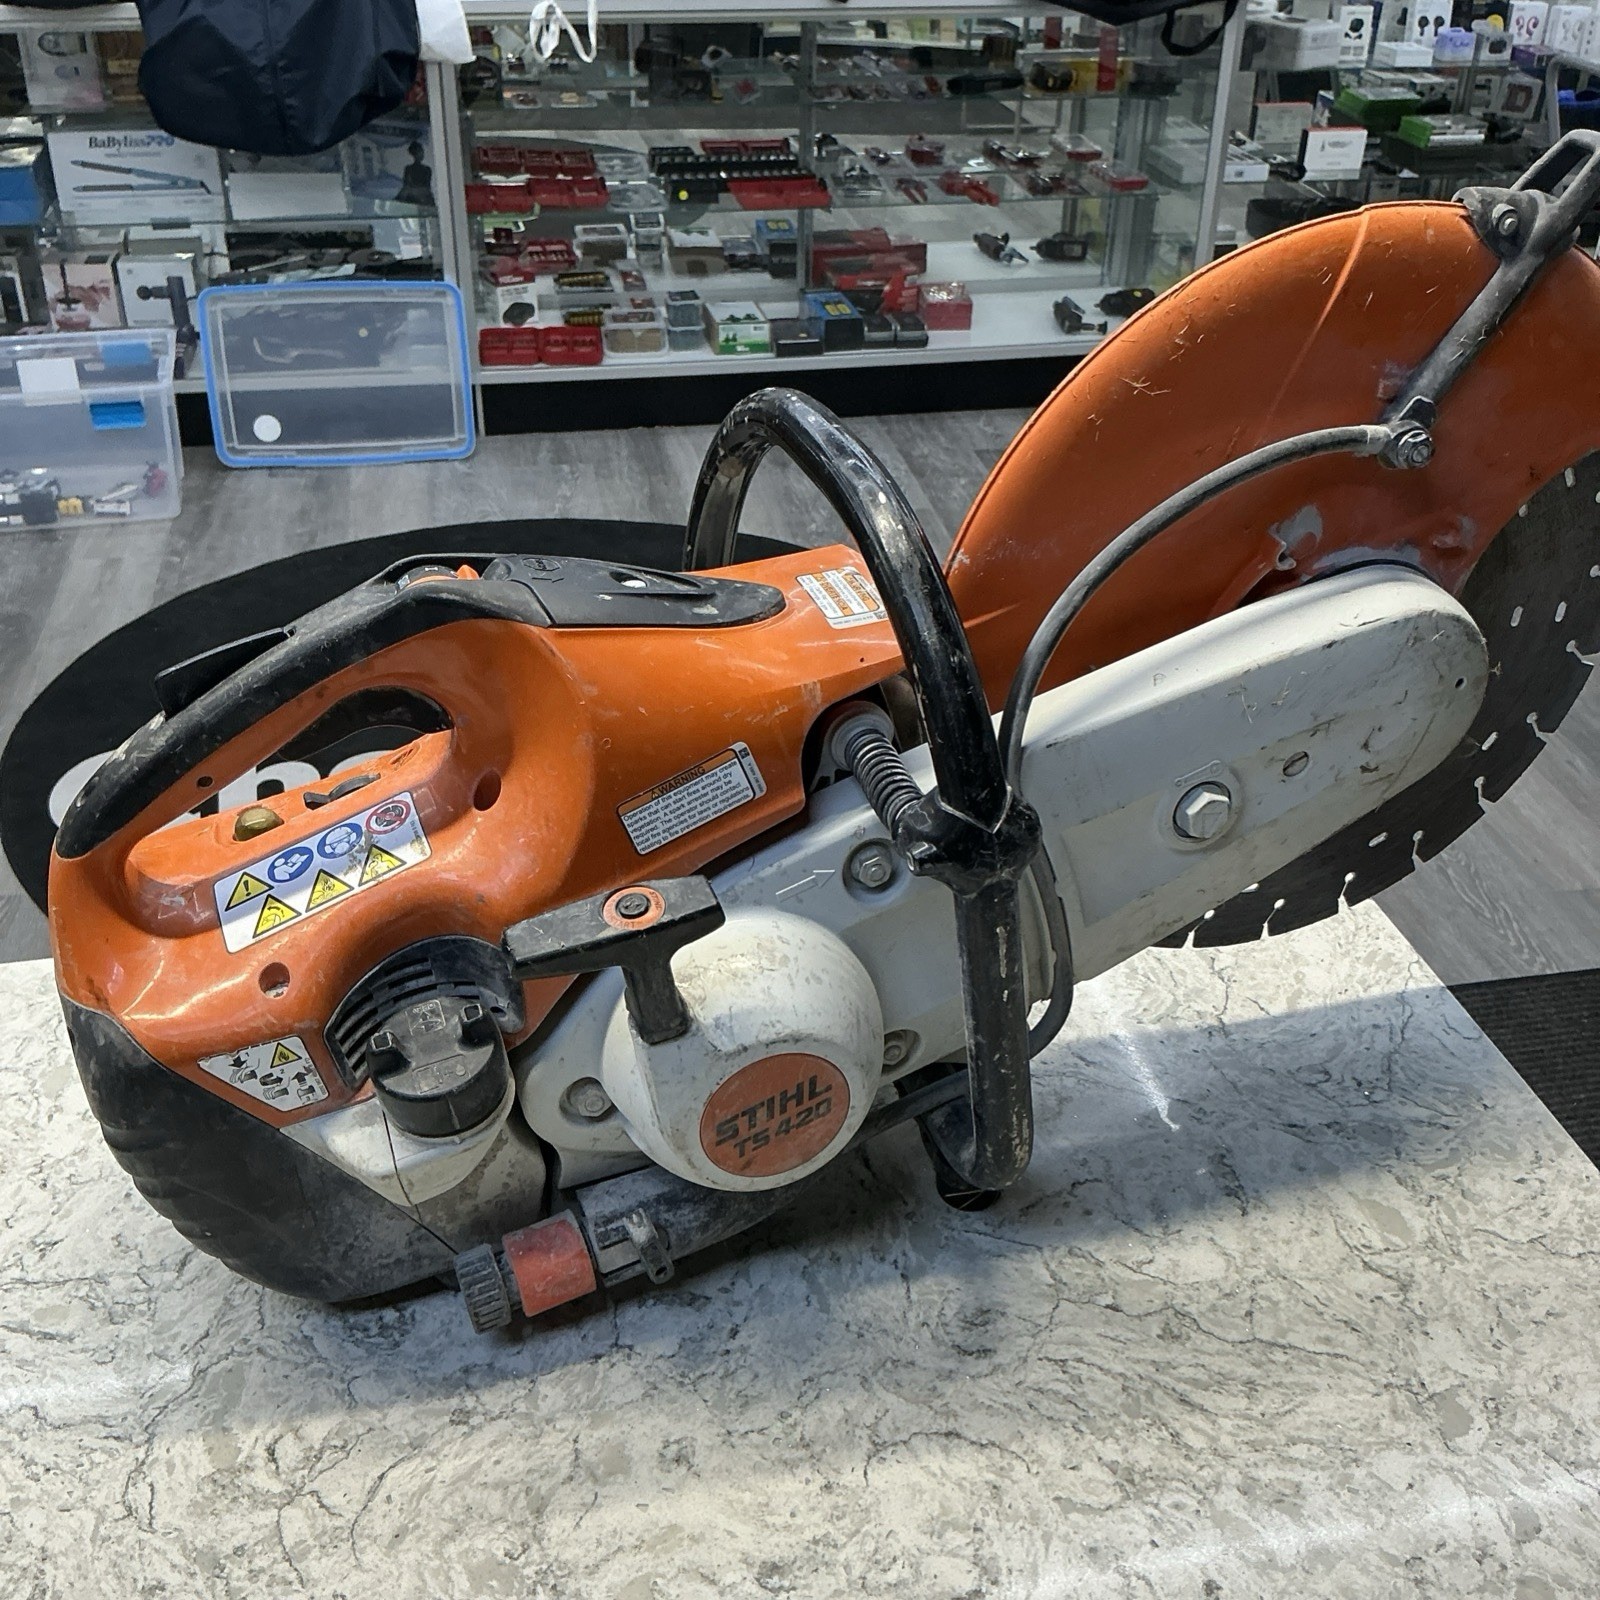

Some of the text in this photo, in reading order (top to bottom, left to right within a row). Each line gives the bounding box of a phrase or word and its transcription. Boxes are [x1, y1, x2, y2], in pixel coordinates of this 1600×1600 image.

[623, 804, 653, 821] Operation
[660, 794, 672, 803] this
[672, 777, 705, 797] equipment
[704, 771, 718, 780] may
[718, 760, 737, 773] create
[626, 771, 732, 828] sparks that can start fires around dry
[658, 766, 705, 795] WARNING
[668, 803, 686, 815] spark
[710, 784, 723, 793] may
[659, 818, 672, 826] The
[673, 804, 698, 820] operator
[698, 793, 719, 807] should
[719, 782, 741, 796] contact
[635, 836, 650, 847] local
[650, 831, 661, 839] fire
[639, 838, 662, 855] relating
[667, 829, 679, 837] fire
[679, 813, 711, 833] prevention
[715, 1074, 832, 1147] STIHL
[733, 1097, 832, 1158] TS 420
